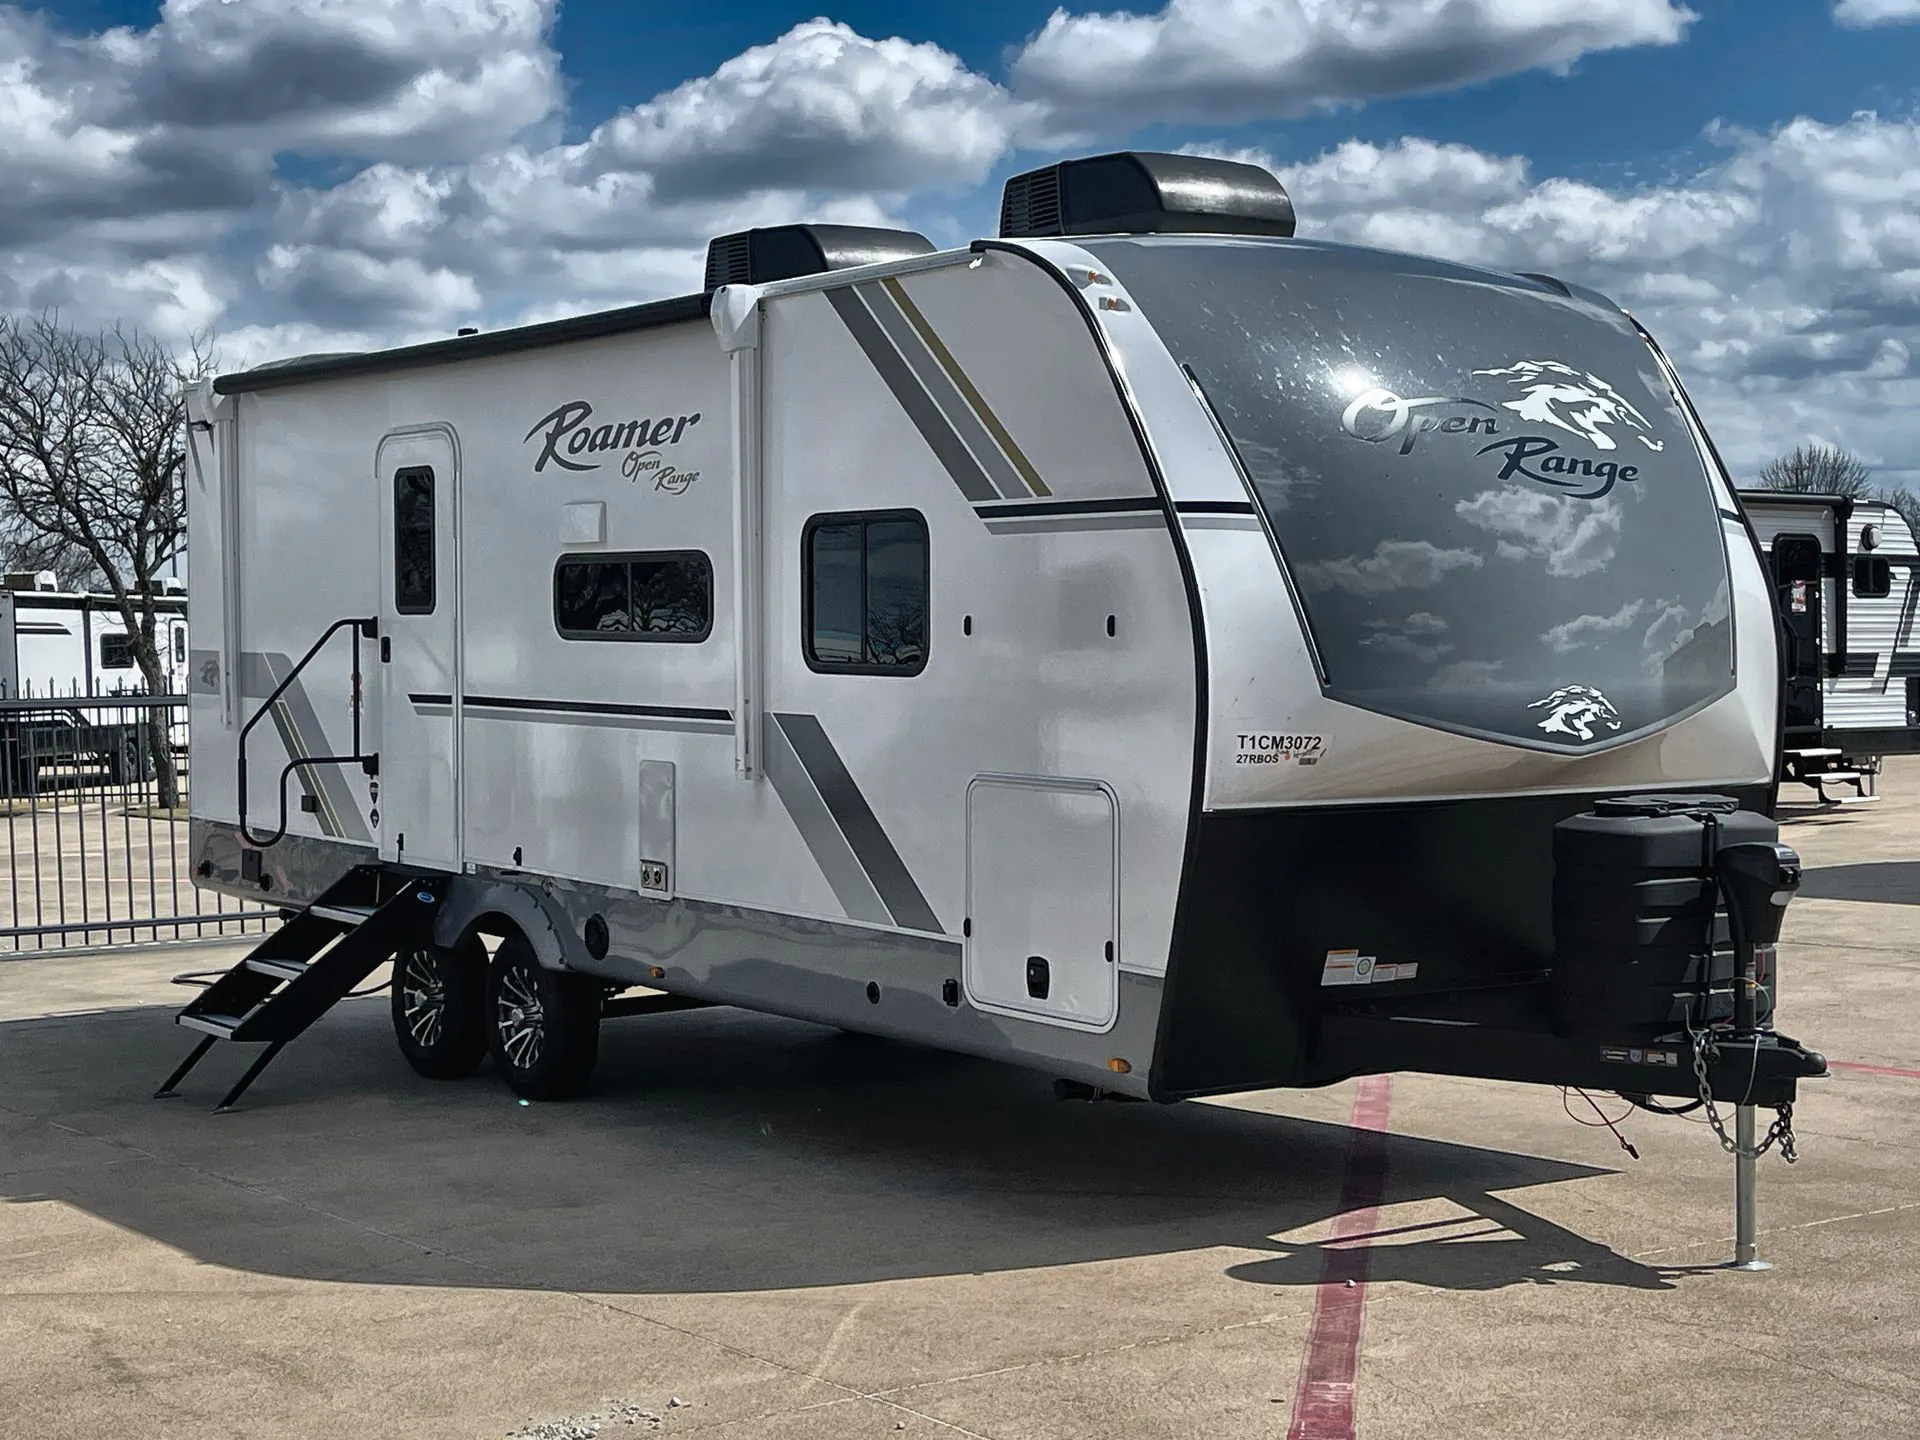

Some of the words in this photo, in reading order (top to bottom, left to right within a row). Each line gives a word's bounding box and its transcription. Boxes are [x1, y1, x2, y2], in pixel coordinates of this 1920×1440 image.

[523, 401, 701, 473] Roamer
[1342, 388, 1500, 455] Open
[621, 451, 662, 483] Open
[651, 466, 700, 495] Range
[1473, 436, 1639, 500] Range
[1237, 735, 1321, 750] T1CM3072
[1236, 754, 1279, 764] 27RBOS
